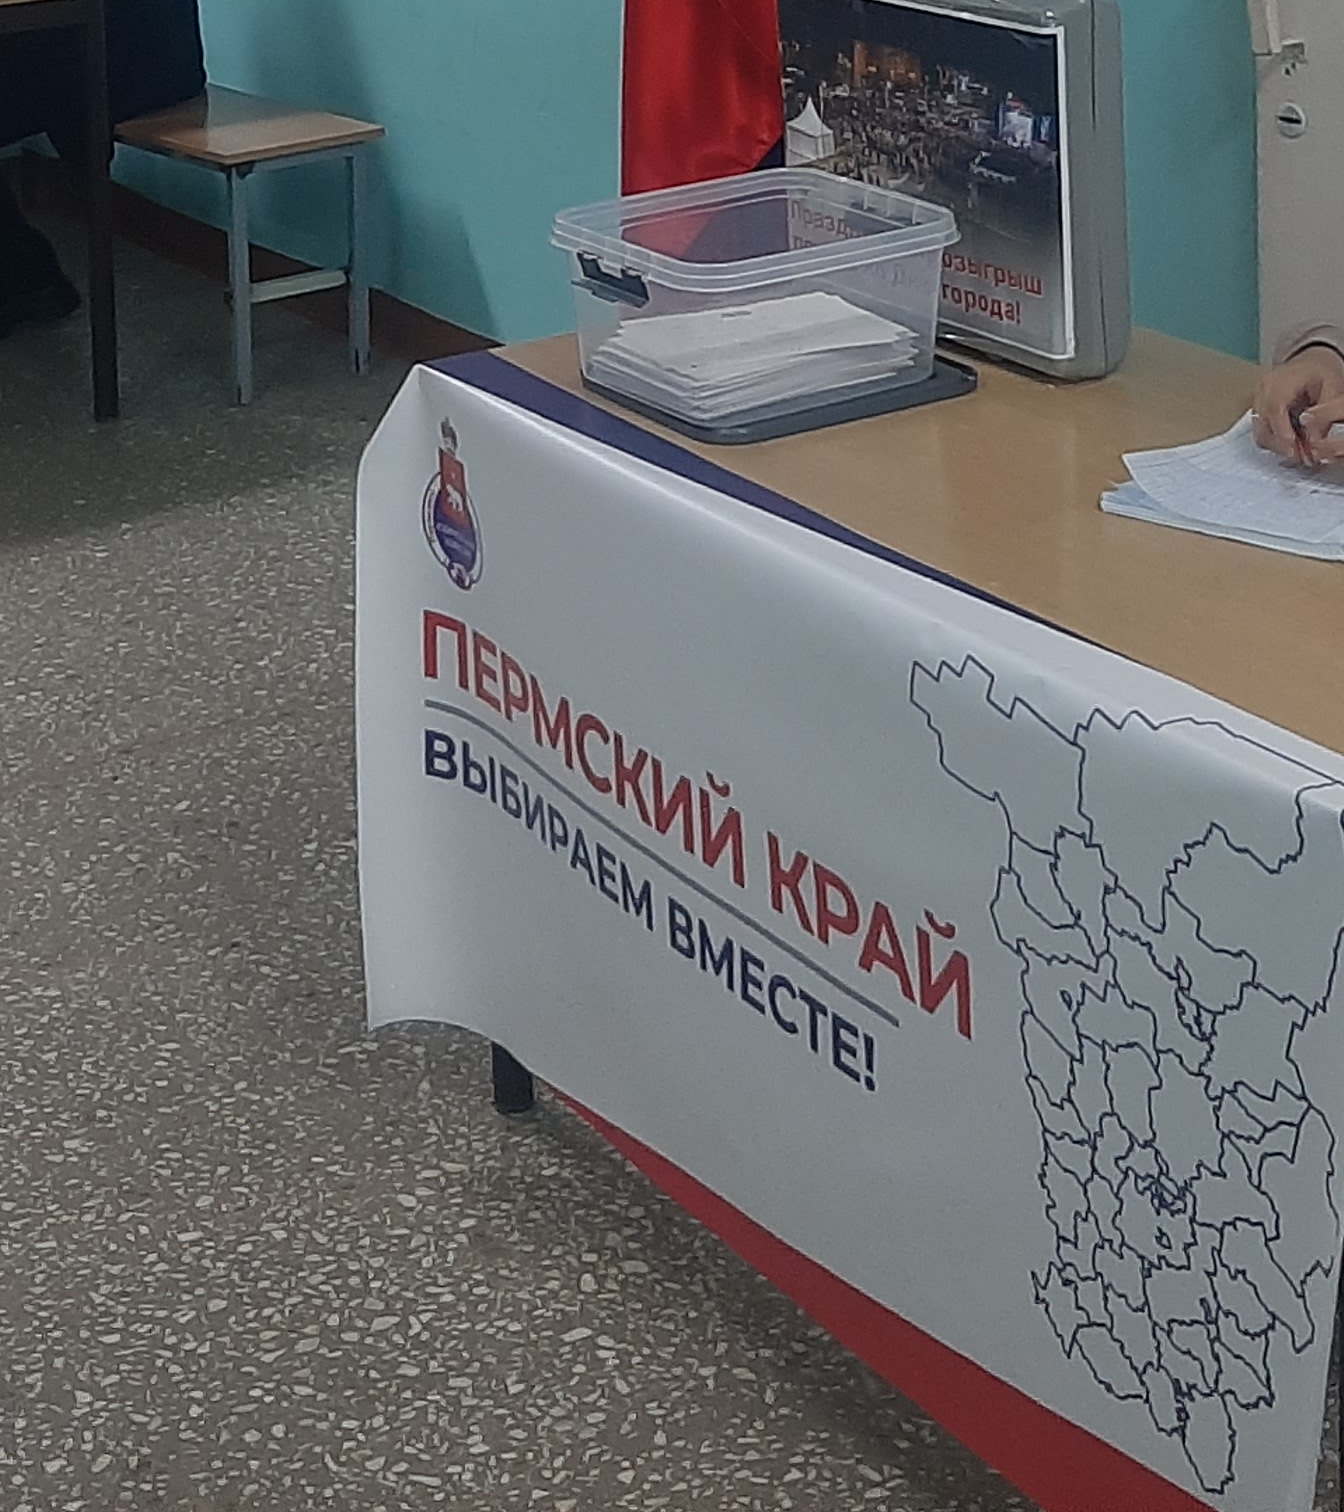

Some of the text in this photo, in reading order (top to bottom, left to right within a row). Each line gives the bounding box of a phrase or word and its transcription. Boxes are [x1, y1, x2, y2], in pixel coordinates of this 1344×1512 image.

[942, 251, 1043, 297] озыгрыш
[942, 283, 1021, 324] города!
[423, 608, 972, 1040] ПЕРМСКИЙ КРАЙ
[423, 728, 876, 1092] ВЫБИРАЕМ ВМЕСТЕ!
